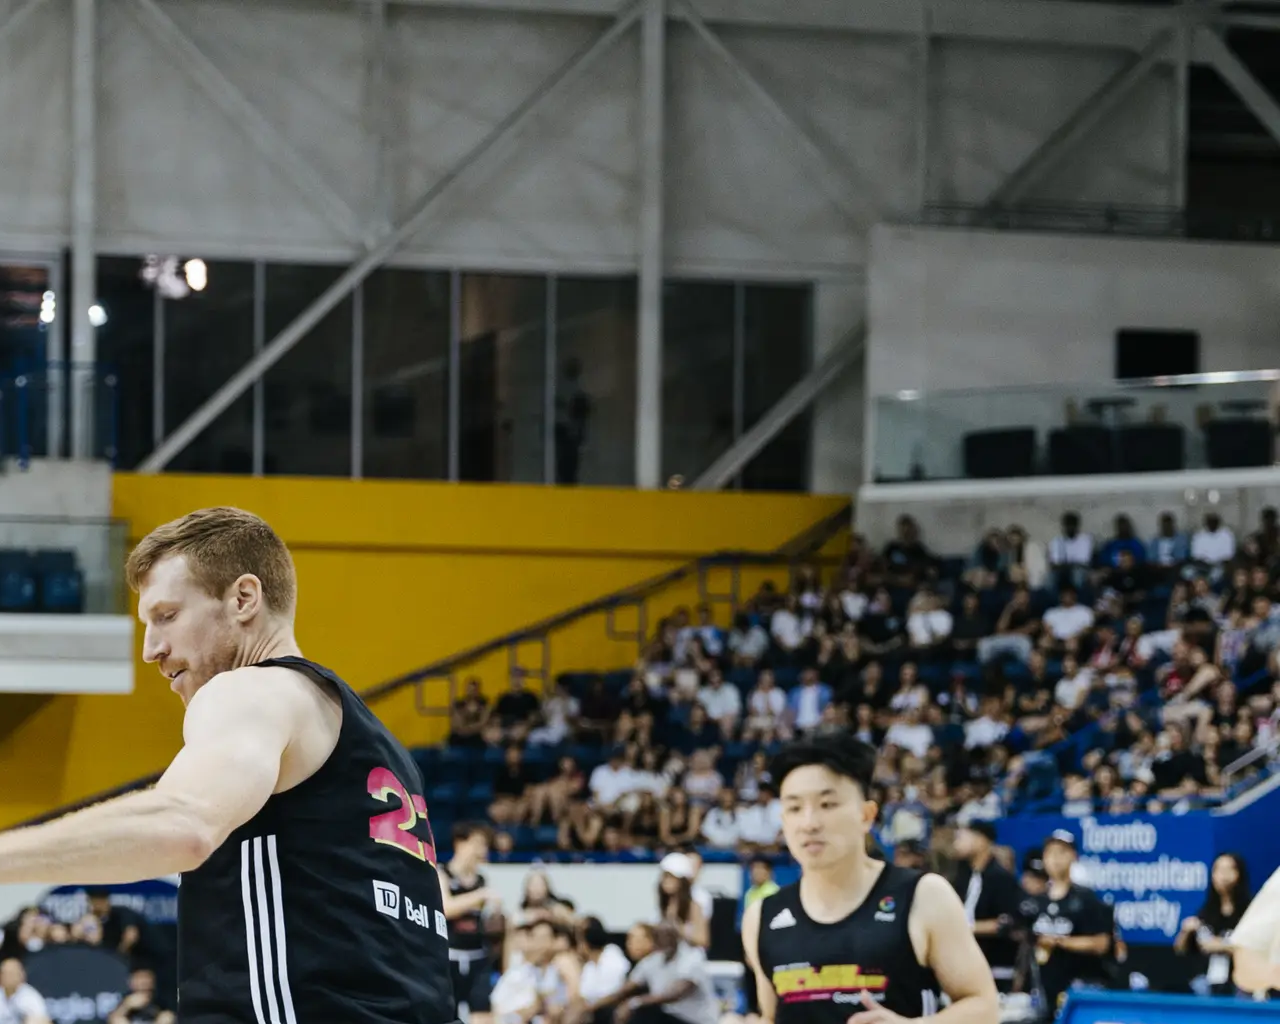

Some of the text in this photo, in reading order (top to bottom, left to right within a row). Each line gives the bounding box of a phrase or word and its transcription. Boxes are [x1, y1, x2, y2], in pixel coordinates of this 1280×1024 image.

[1079, 816, 1157, 853] Toronto
[377, 886, 397, 909] TD
[404, 895, 429, 929] Bell
